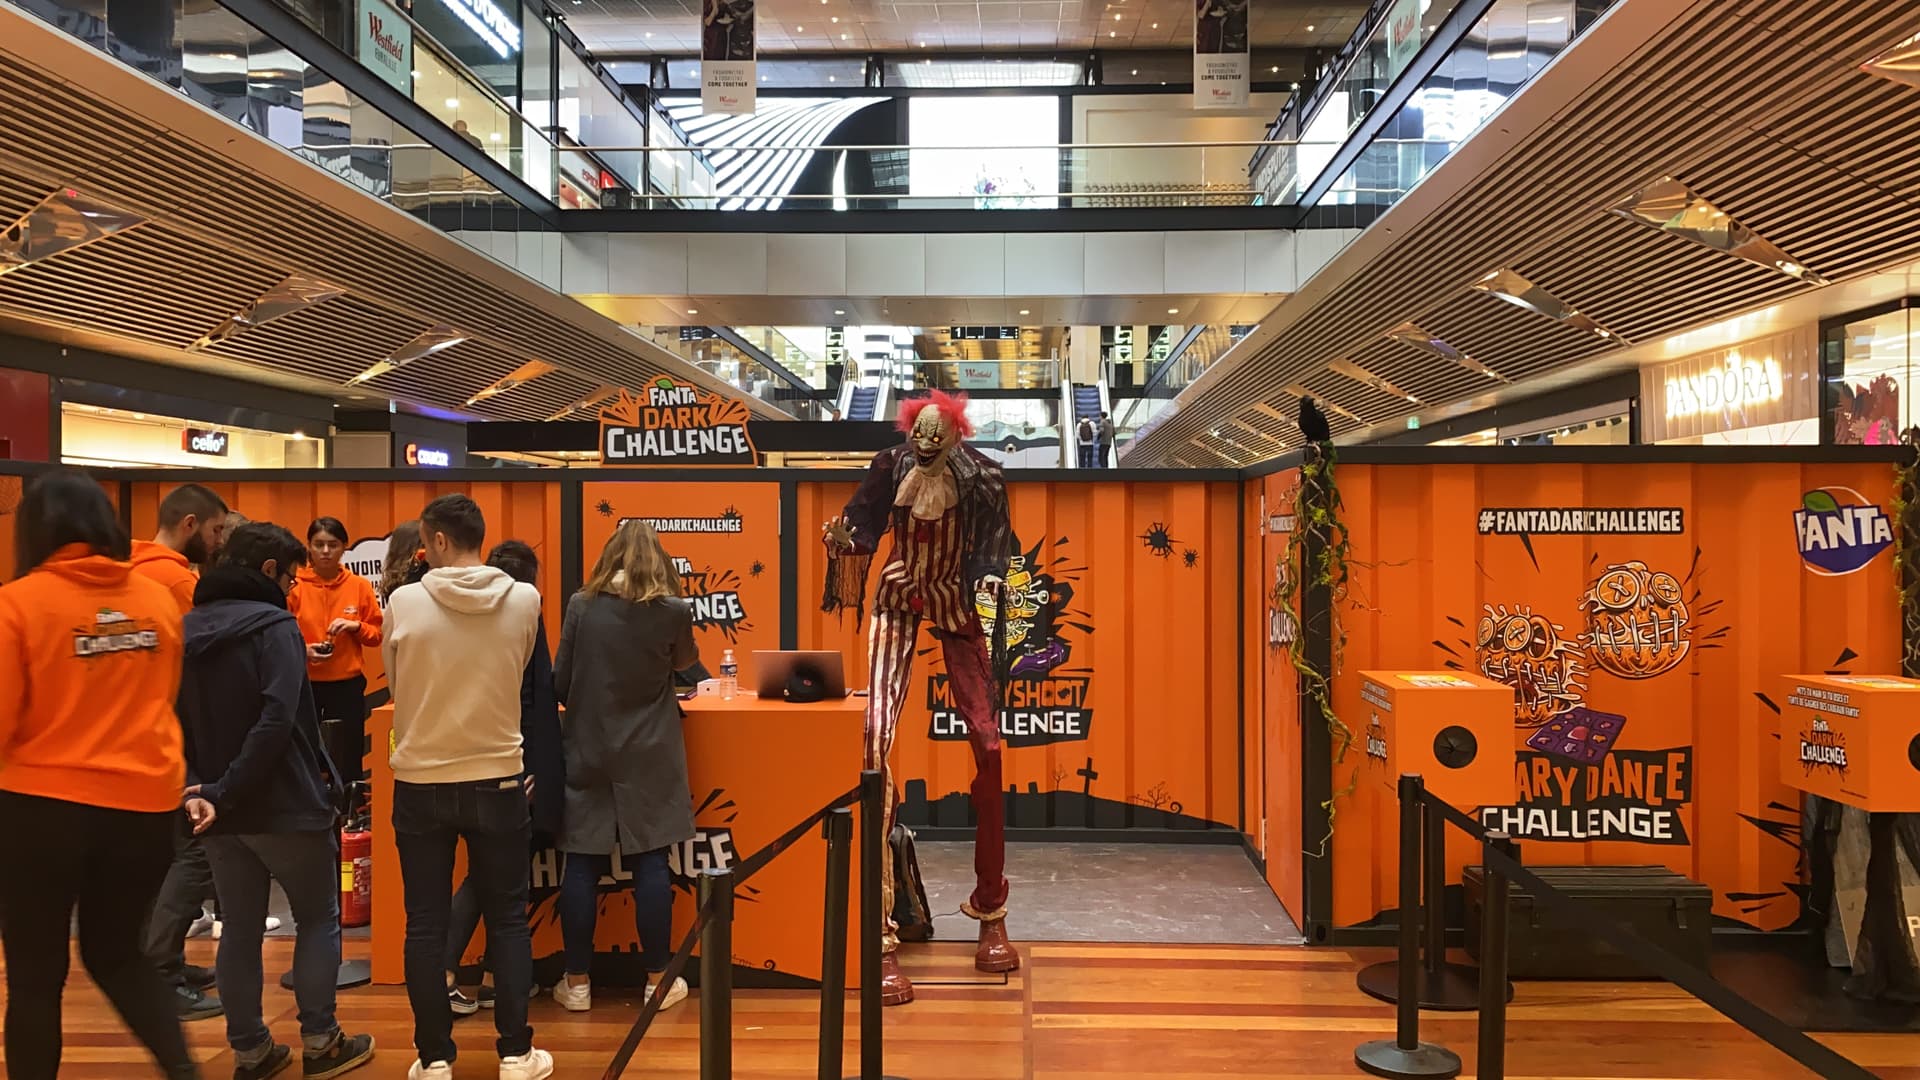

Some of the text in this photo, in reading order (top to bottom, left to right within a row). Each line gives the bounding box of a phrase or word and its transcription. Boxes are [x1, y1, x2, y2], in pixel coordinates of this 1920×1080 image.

[368, 12, 404, 62] Westfield
[649, 387, 697, 407] FANTA
[1665, 354, 1778, 418] PANDORA
[643, 407, 708, 430] DARK
[607, 426, 750, 459] CHALLENGE
[1479, 510, 1682, 532] #FANTADARKCHALLENGE
[1795, 507, 1893, 553] FANTA
[933, 679, 1085, 709] MYSHOOT
[933, 711, 1081, 735] CHLENGE
[1801, 741, 1847, 765] CHALLENGE
[1515, 752, 1686, 806] ARY DANCE
[1483, 807, 1673, 838] CHALLENGE
